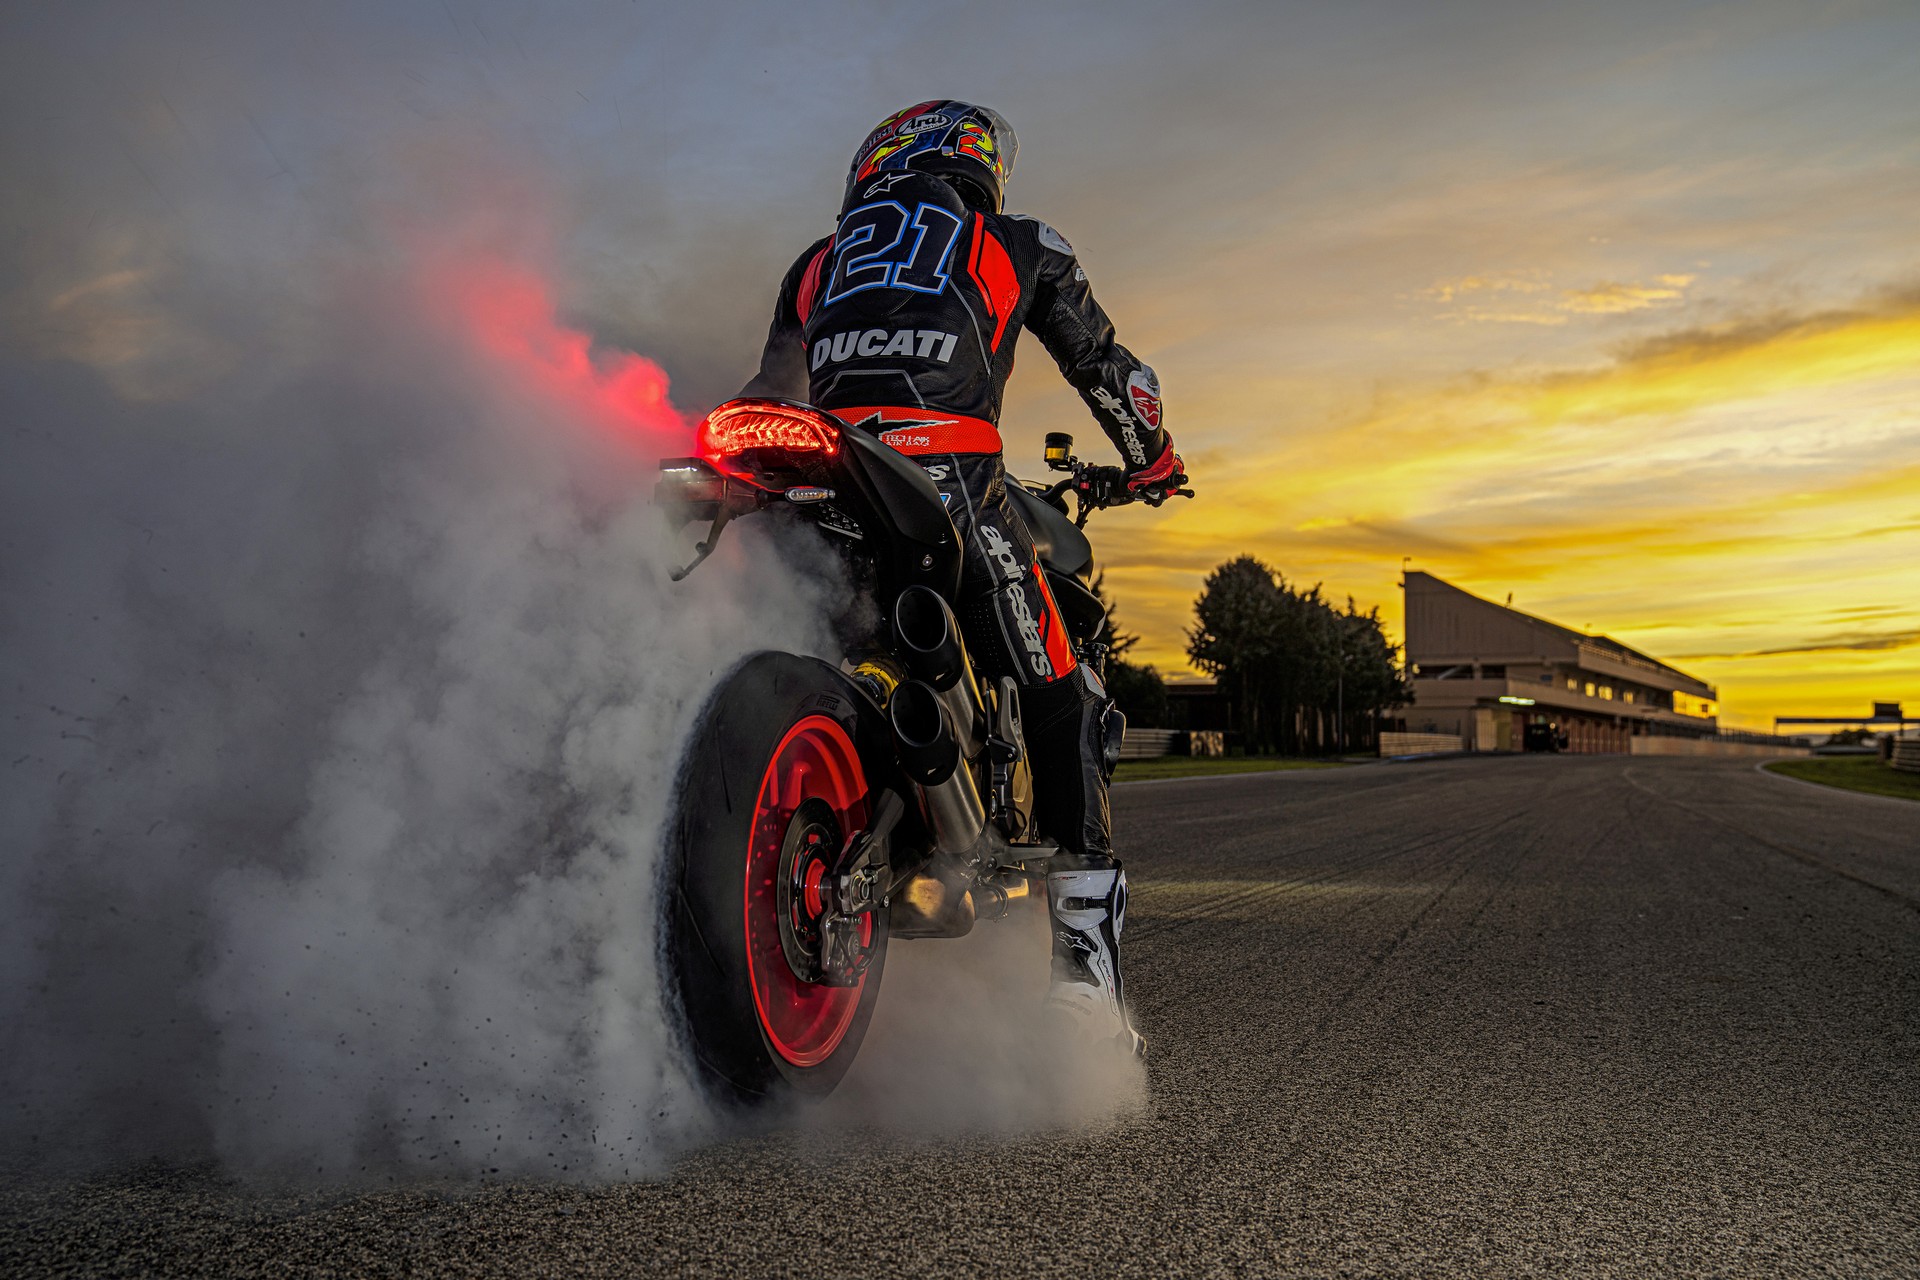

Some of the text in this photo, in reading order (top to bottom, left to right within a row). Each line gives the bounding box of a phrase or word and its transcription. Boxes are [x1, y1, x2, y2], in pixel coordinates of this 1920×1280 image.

[901, 113, 945, 132] Arai
[823, 200, 963, 307] 21
[812, 329, 959, 373] DUCATI
